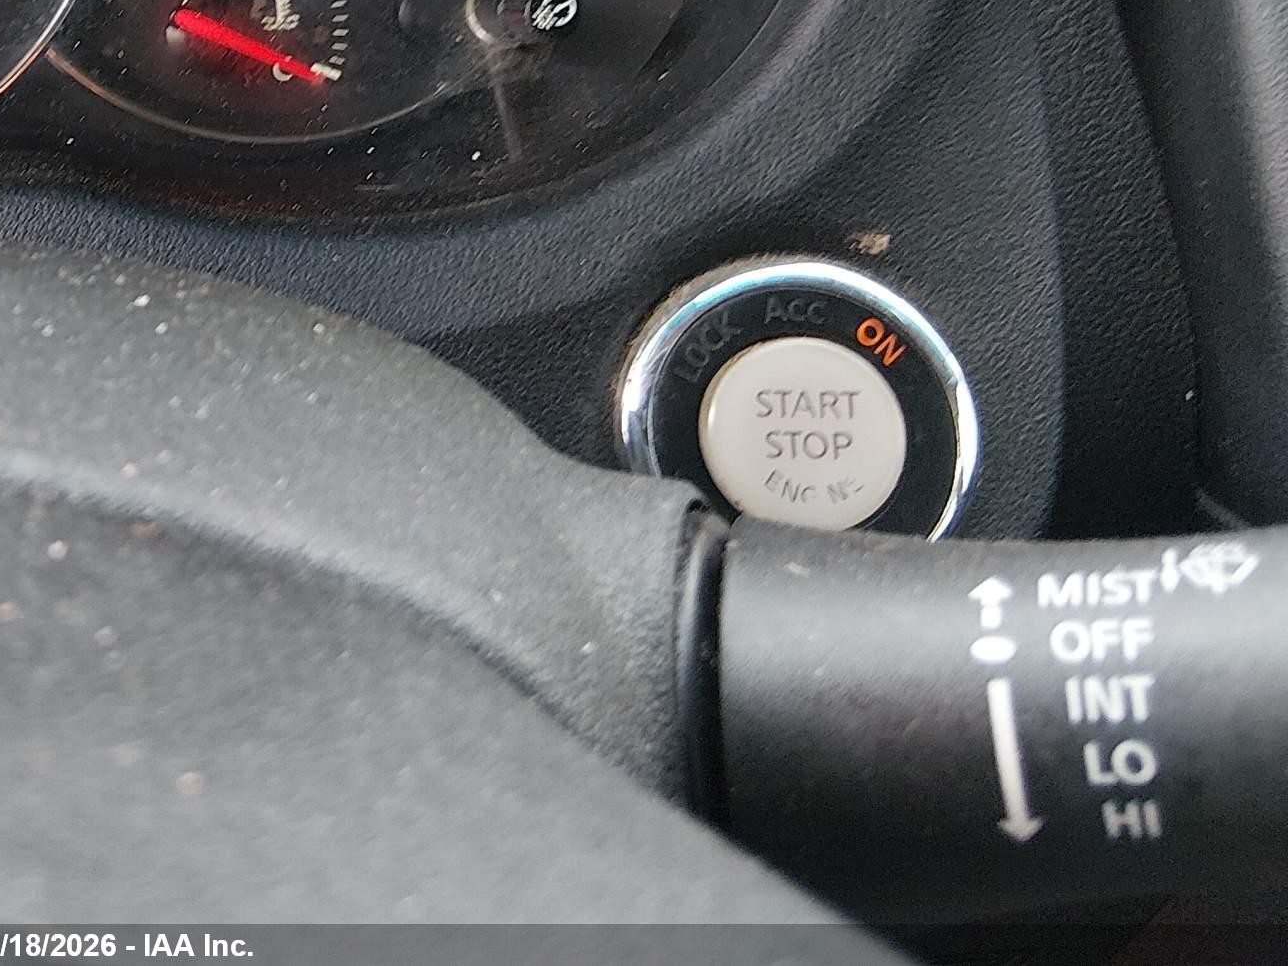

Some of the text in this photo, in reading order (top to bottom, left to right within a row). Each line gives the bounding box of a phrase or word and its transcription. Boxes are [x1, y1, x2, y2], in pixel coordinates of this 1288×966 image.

[764, 296, 827, 324] ACC
[856, 316, 908, 369] ON
[755, 389, 861, 420] START
[764, 430, 853, 461] STOP
[764, 468, 865, 504] ENGNE
[1037, 568, 1159, 608] MIST
[1050, 618, 1156, 662] OFF
[1065, 674, 1156, 724] INT
[1083, 738, 1159, 786] LO
[1102, 799, 1161, 839] HI
